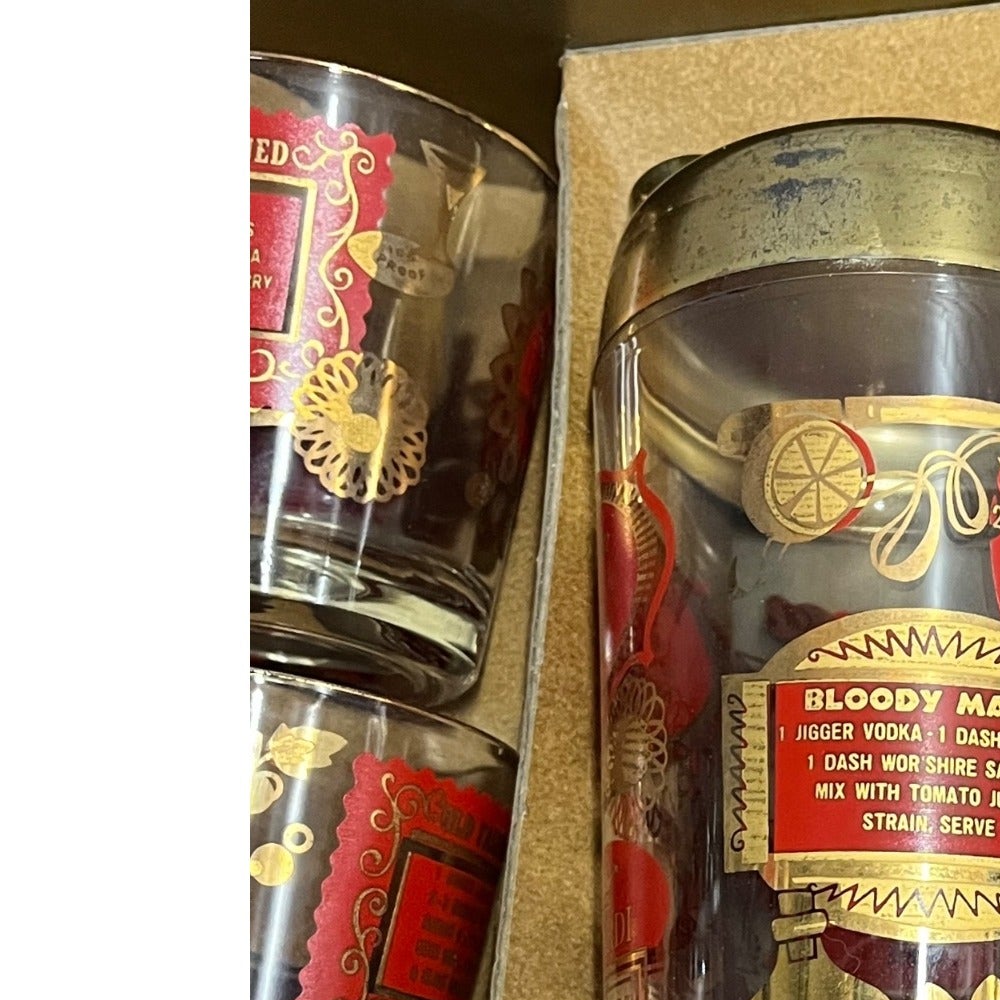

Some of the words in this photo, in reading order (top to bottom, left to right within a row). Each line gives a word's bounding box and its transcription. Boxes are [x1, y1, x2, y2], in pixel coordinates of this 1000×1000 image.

[804, 687, 943, 714] BLOODY
[779, 726, 785, 742] 1
[795, 722, 854, 743] JIGGER
[807, 755, 814, 771] 1
[824, 753, 872, 772] DASH
[815, 783, 846, 800] MIX
[855, 783, 900, 801] WITH
[909, 784, 981, 807] TOMATO
[939, 816, 996, 838] SERVE
